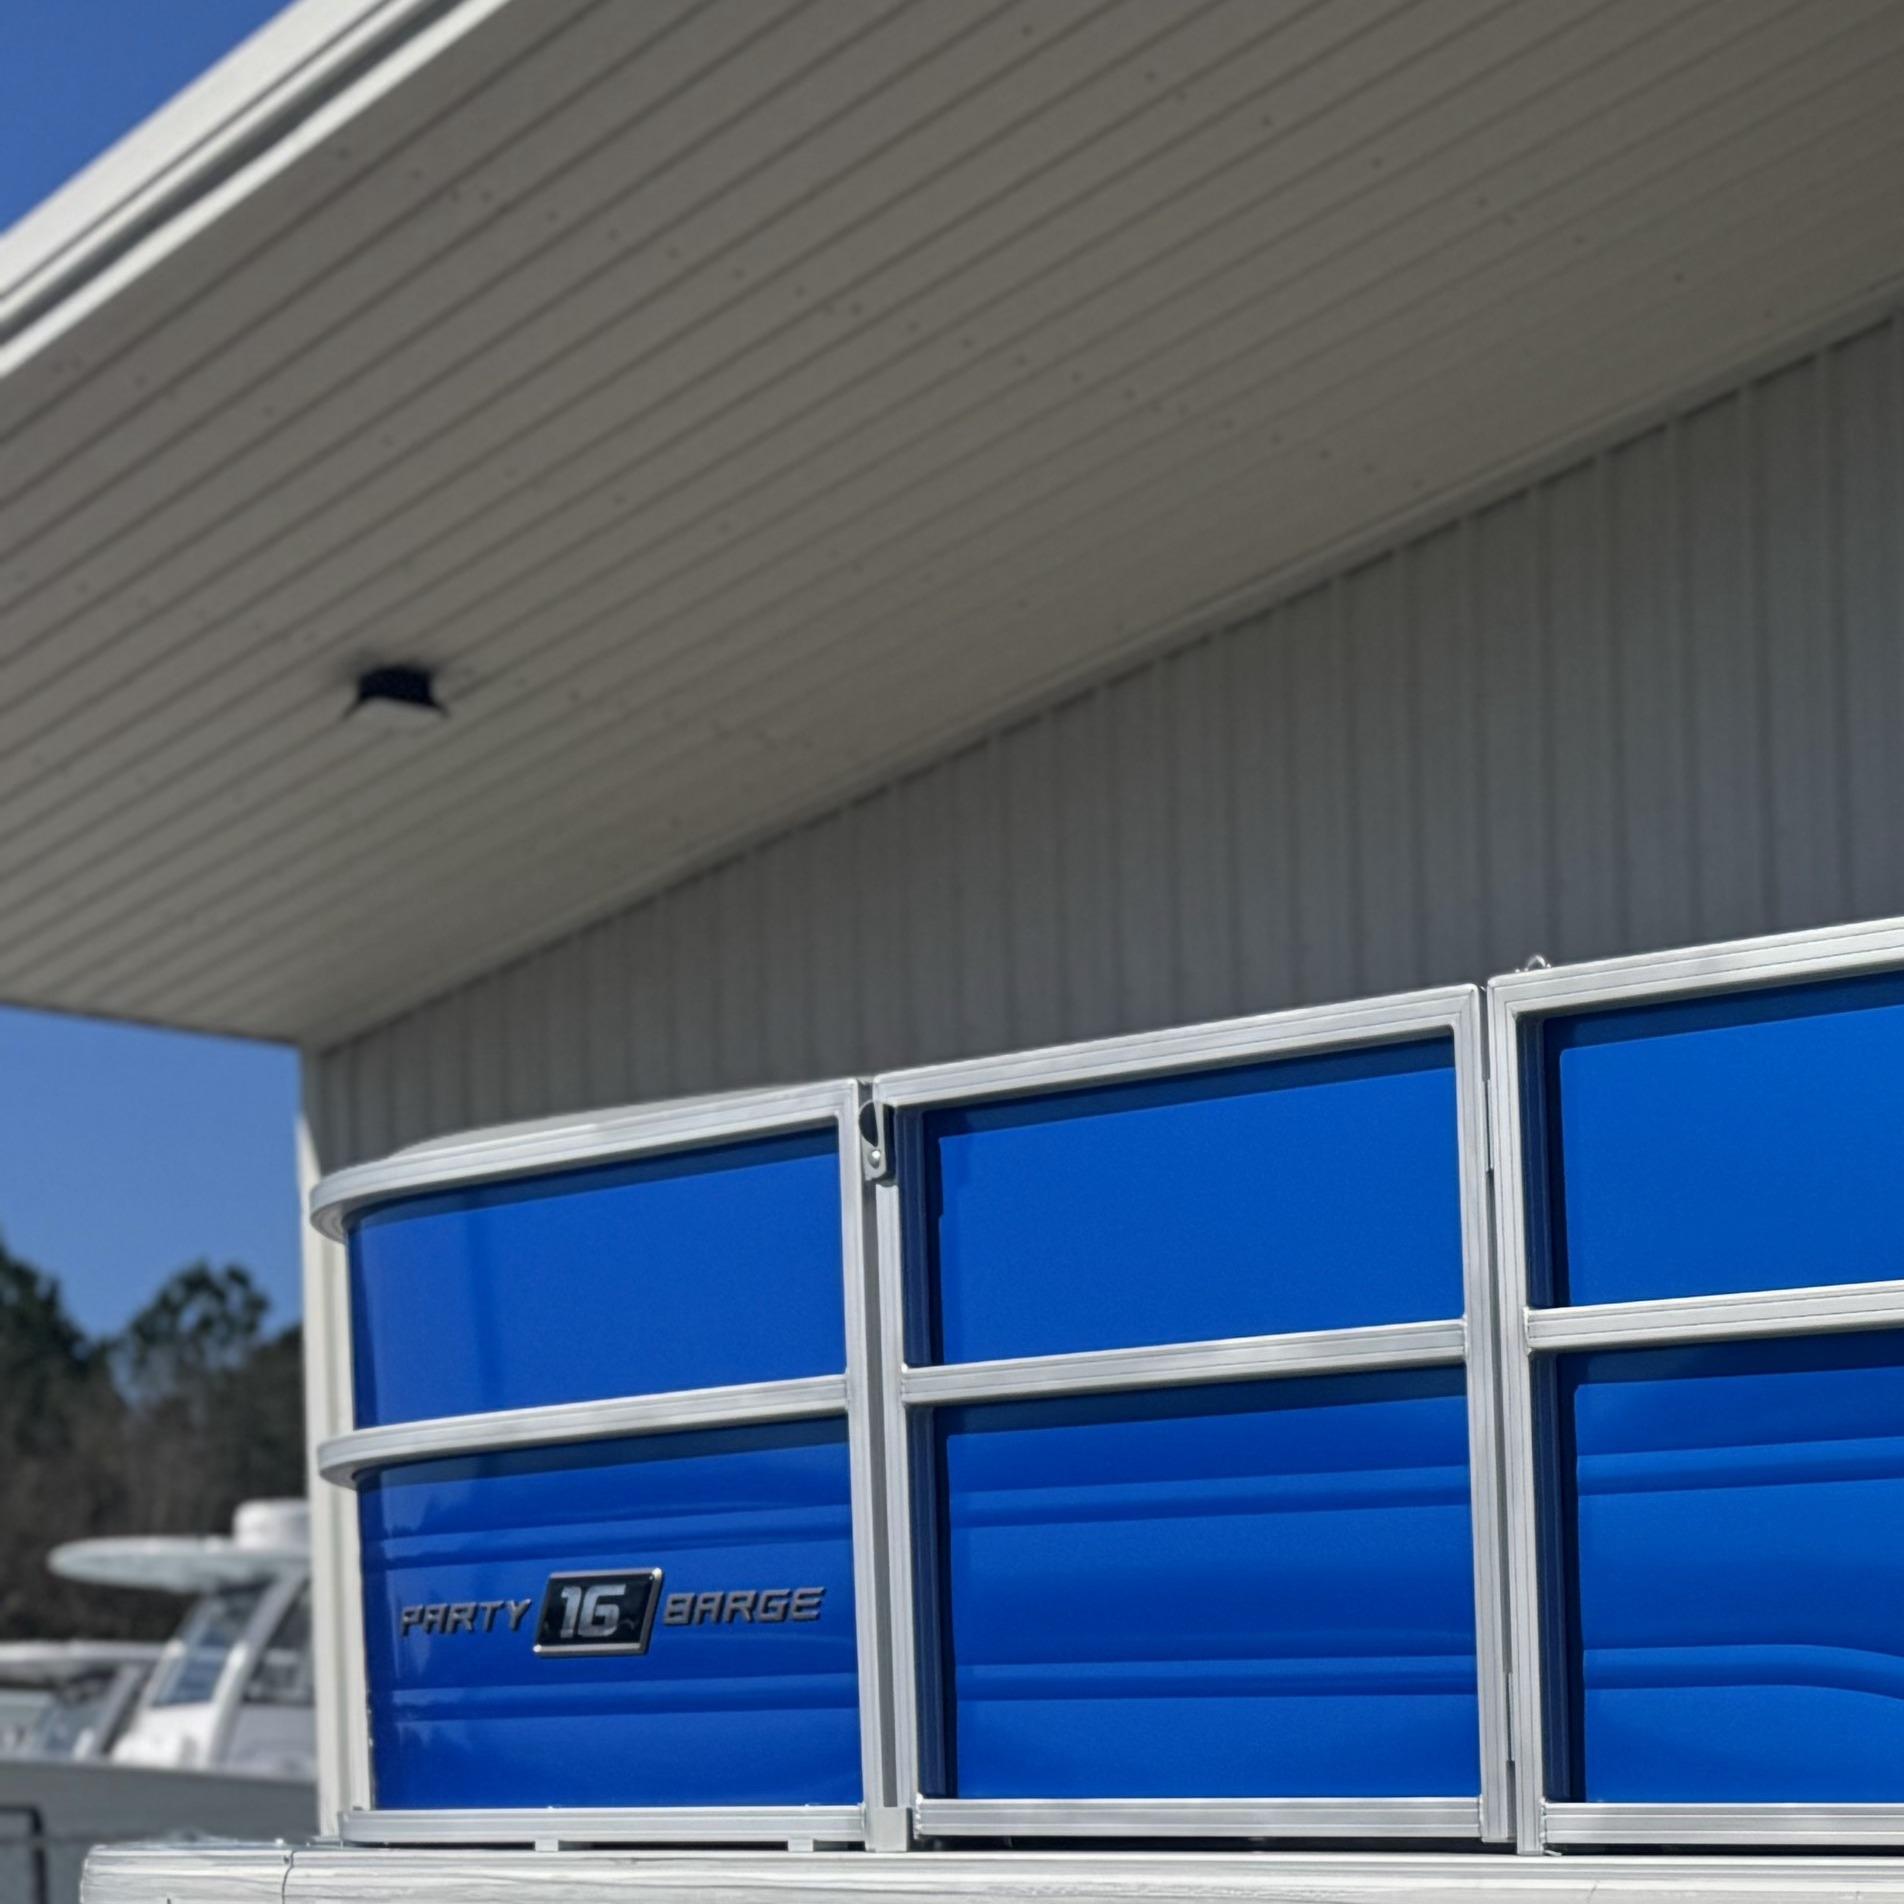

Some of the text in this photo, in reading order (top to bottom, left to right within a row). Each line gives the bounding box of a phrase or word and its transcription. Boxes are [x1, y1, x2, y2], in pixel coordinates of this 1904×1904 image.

[401, 1583, 826, 1640] PARTY 16 BARGE
